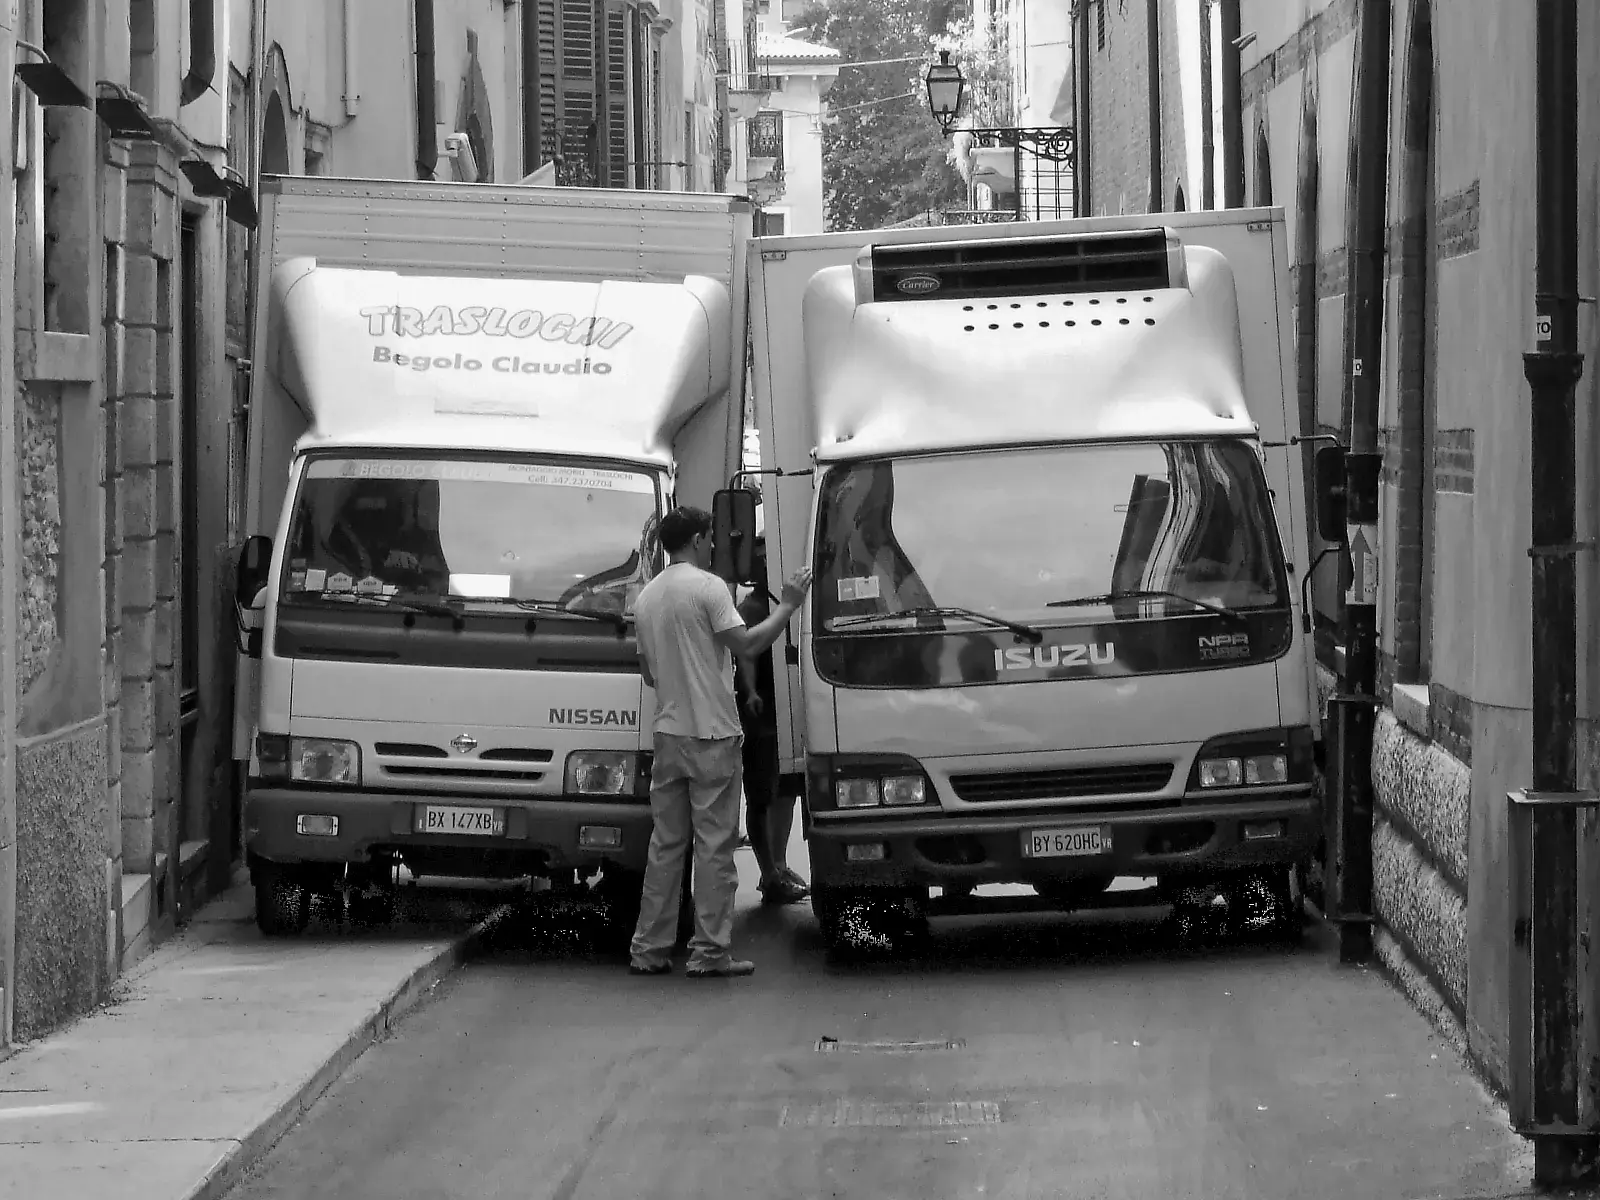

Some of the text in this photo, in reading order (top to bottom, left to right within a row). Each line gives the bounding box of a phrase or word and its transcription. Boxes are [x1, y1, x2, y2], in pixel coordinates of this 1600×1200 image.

[360, 305, 633, 349] TRASLOCHI
[373, 346, 612, 375] Begolo Claudio
[1199, 634, 1249, 646] NPR
[994, 642, 1115, 670] ISUZU
[549, 708, 637, 725] NISSAN
[428, 811, 445, 828] BX
[1034, 835, 1050, 852] BY
